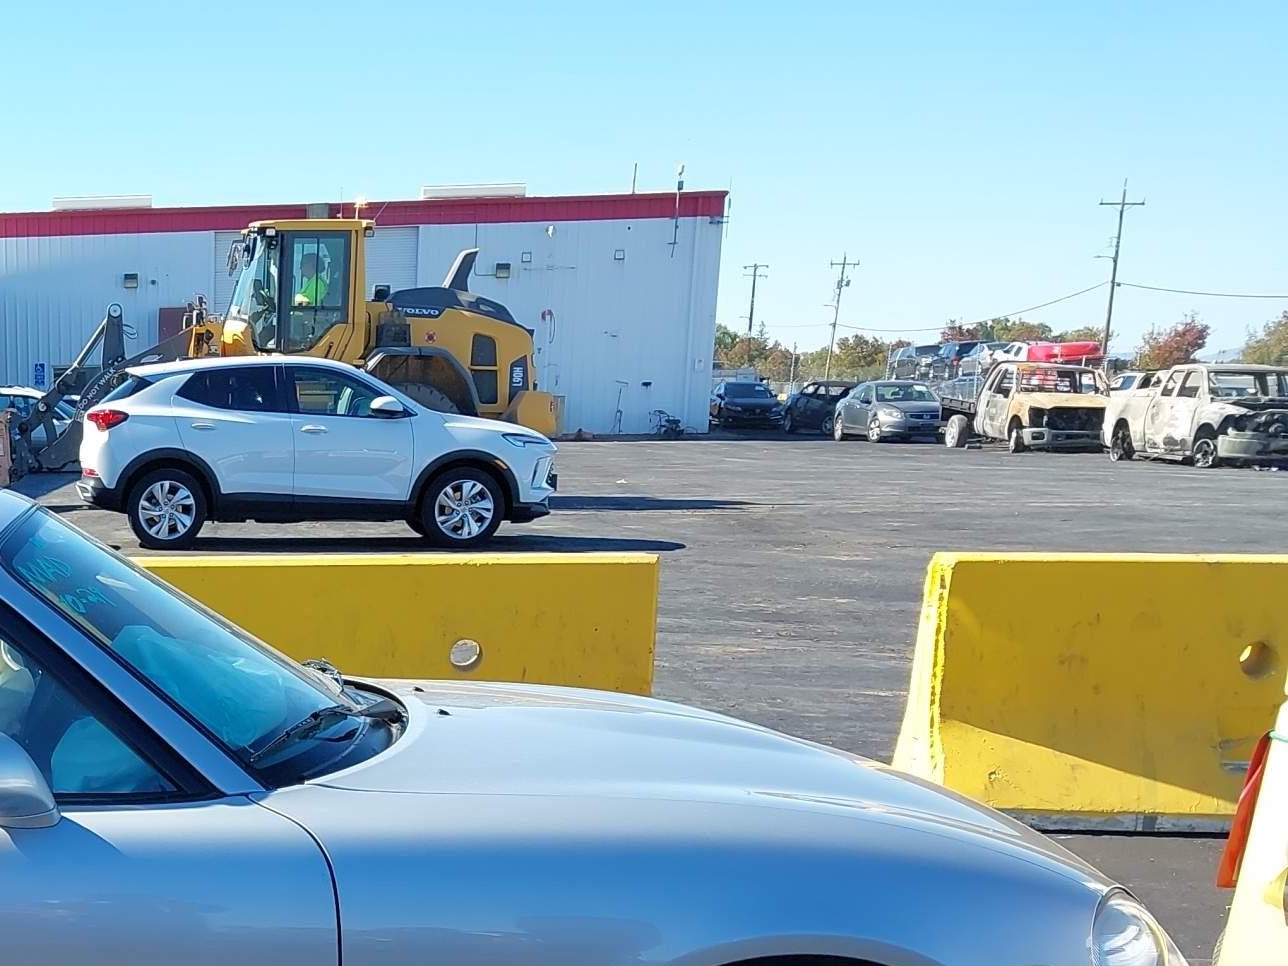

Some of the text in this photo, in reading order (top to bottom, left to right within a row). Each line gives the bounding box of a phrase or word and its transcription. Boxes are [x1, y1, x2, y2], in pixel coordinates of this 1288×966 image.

[397, 307, 439, 316] VOLVO
[511, 367, 523, 387] L90H
[78, 367, 116, 410] DO NOT WALK
